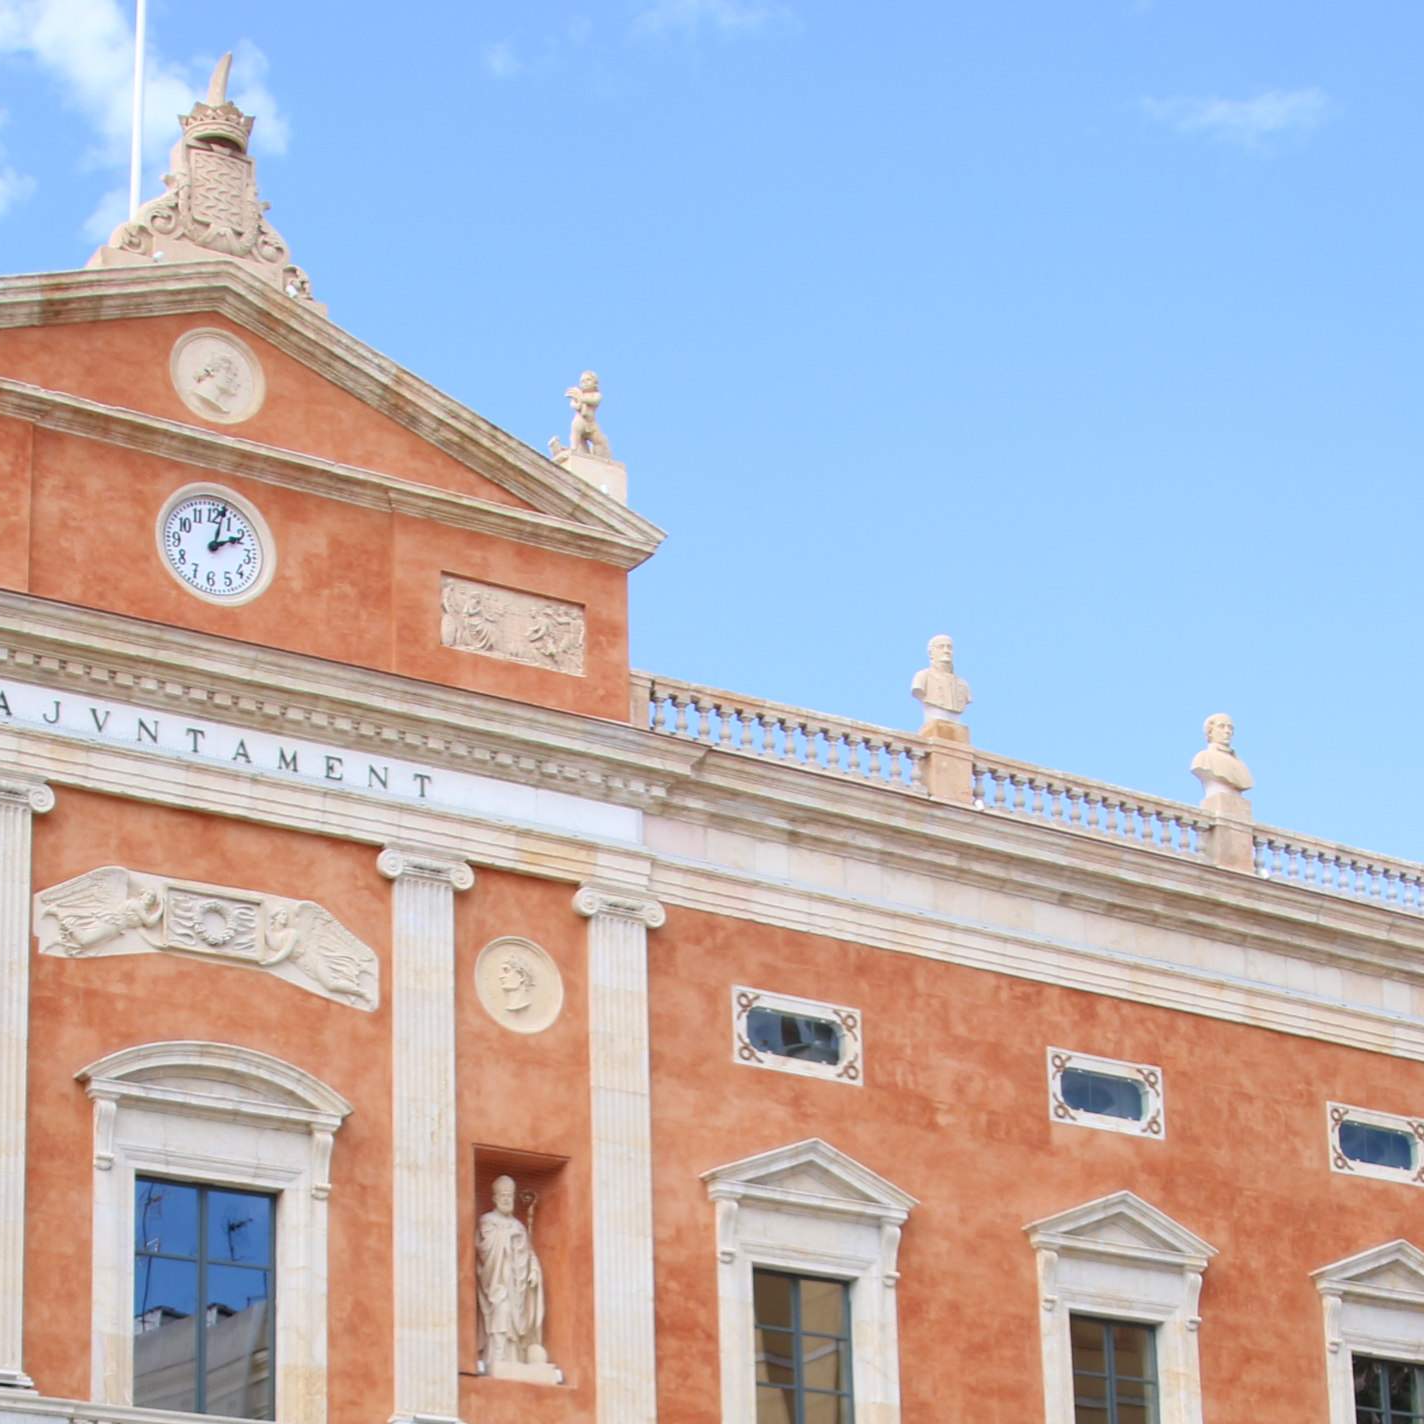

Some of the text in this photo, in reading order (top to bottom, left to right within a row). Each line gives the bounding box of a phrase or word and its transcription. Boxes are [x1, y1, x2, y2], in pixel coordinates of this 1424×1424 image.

[193, 508, 202, 524] 11
[179, 517, 191, 533] 10
[172, 531, 181, 547] 9
[178, 549, 186, 565] 8
[243, 548, 251, 564] 3
[191, 562, 199, 579] 7
[236, 564, 244, 579] 4
[206, 571, 216, 587] 6
[223, 571, 232, 587] 5
